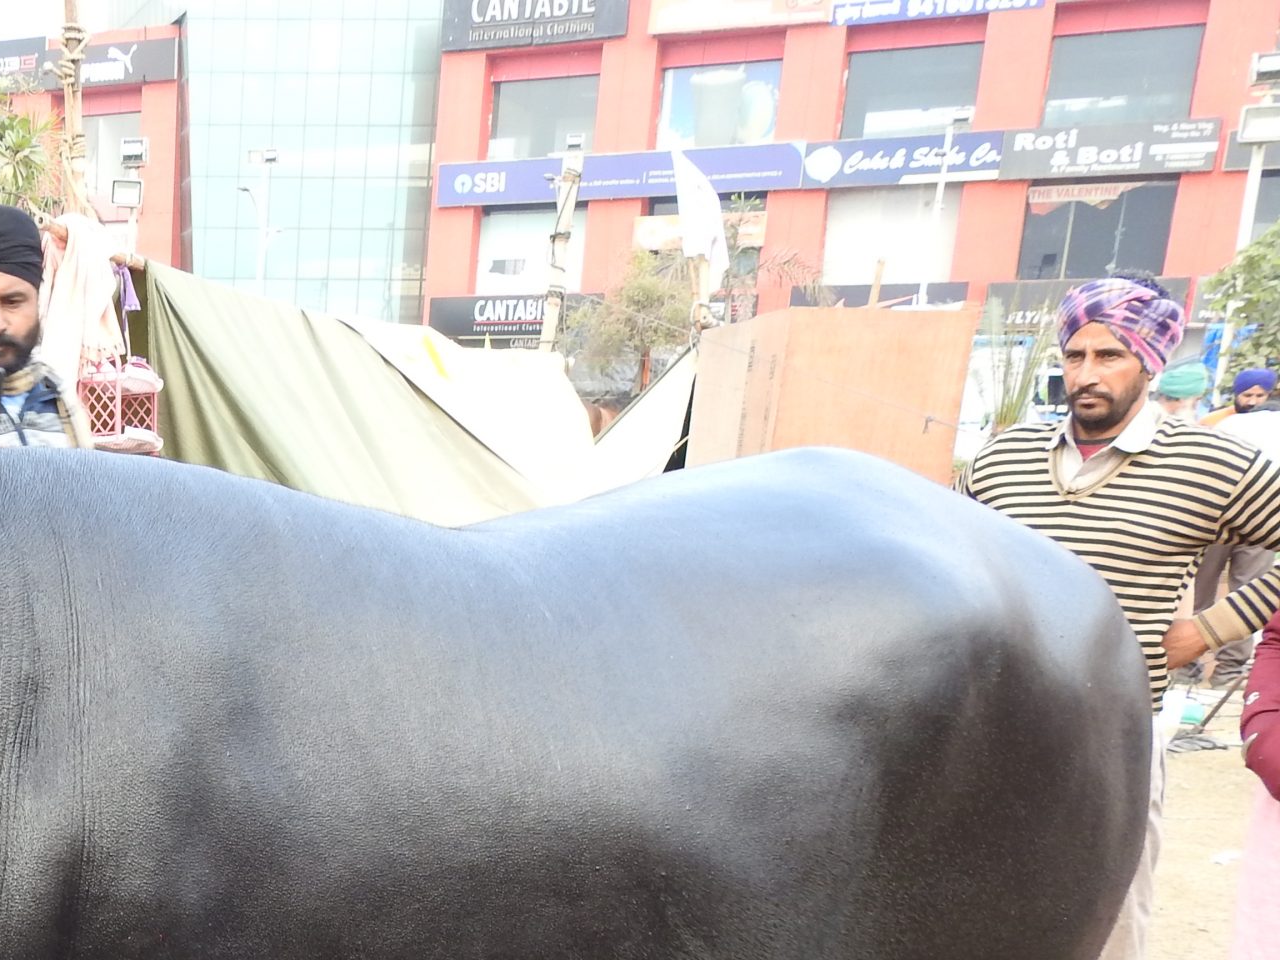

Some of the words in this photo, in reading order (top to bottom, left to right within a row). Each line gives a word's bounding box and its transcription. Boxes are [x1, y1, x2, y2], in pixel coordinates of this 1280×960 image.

[547, 22, 595, 36] Clothing
[1013, 128, 1079, 151] Roti
[1076, 141, 1145, 165] Boti
[473, 171, 507, 194] SBI
[474, 299, 545, 321] CANTABI
